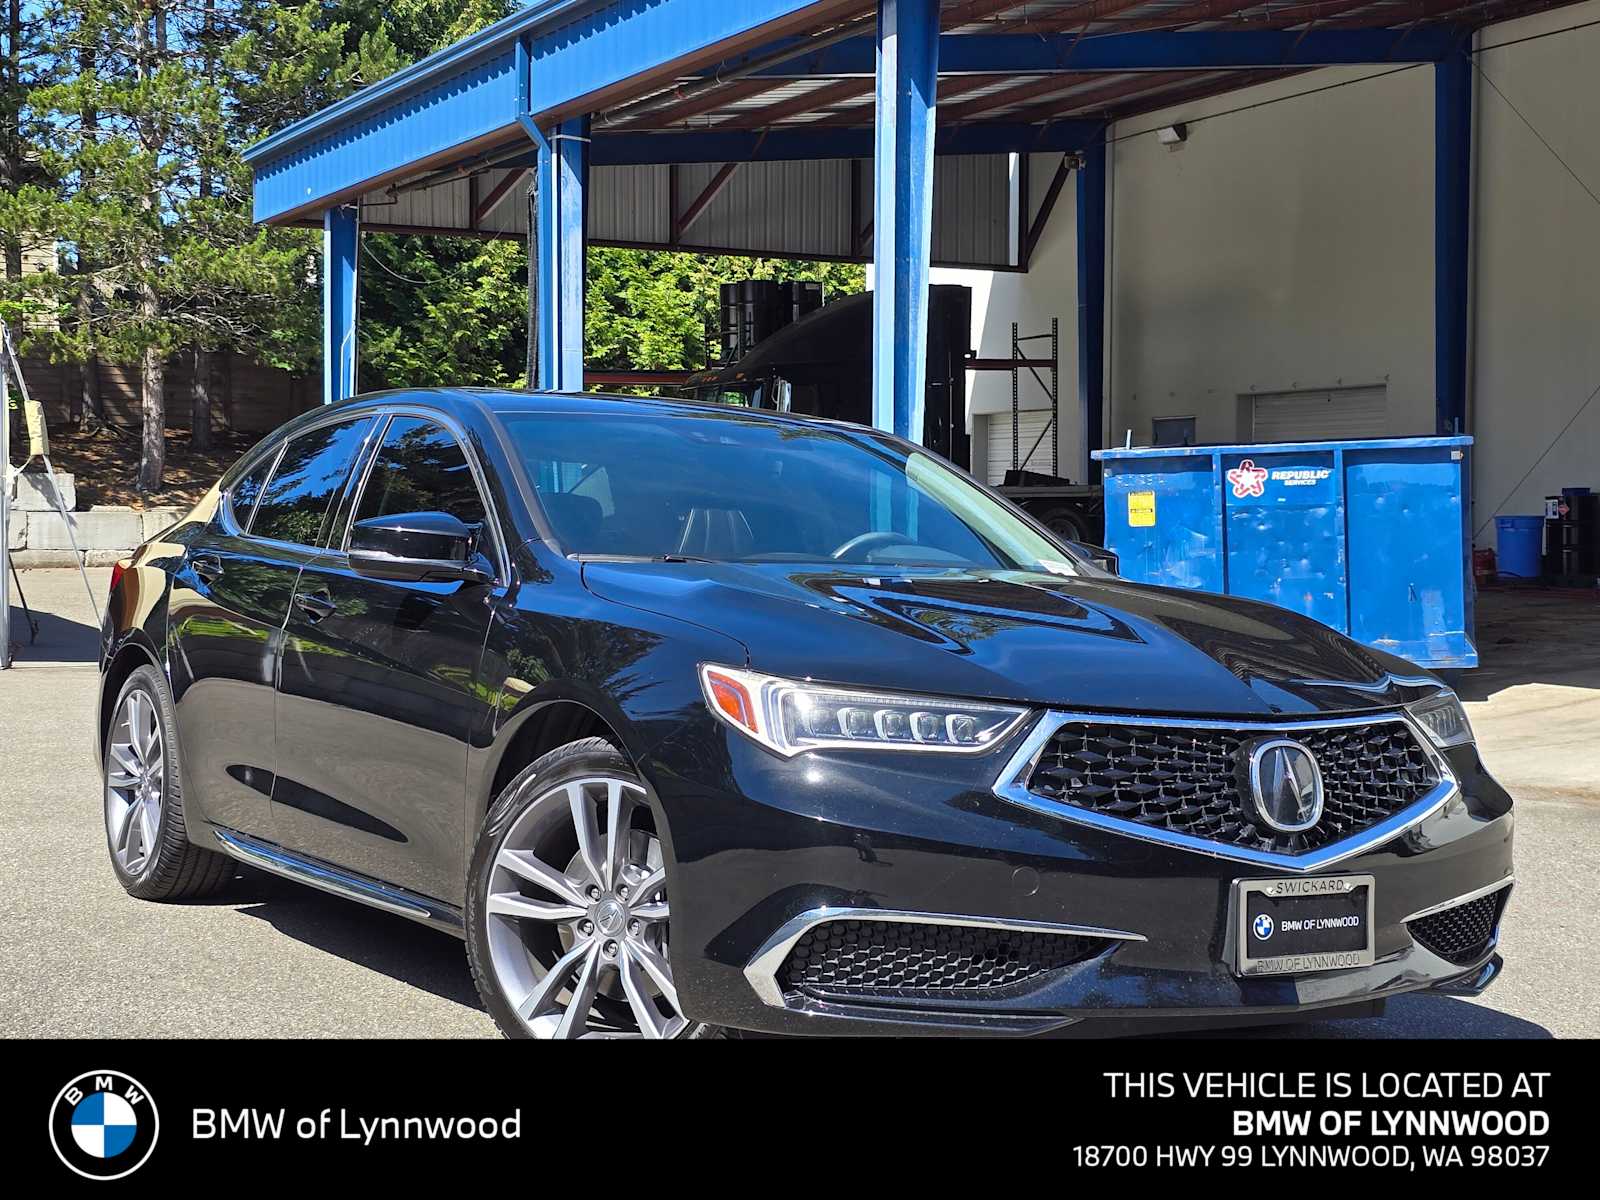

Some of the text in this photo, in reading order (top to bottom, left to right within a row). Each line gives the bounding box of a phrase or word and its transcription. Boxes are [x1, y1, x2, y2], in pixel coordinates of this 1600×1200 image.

[1271, 469, 1330, 481] REPUBLIC
[1276, 879, 1344, 894] SWICKARD
[1281, 916, 1359, 932] BMW OF LYNNWOOD
[1257, 953, 1360, 973] BMW OF LYNNWOOD
